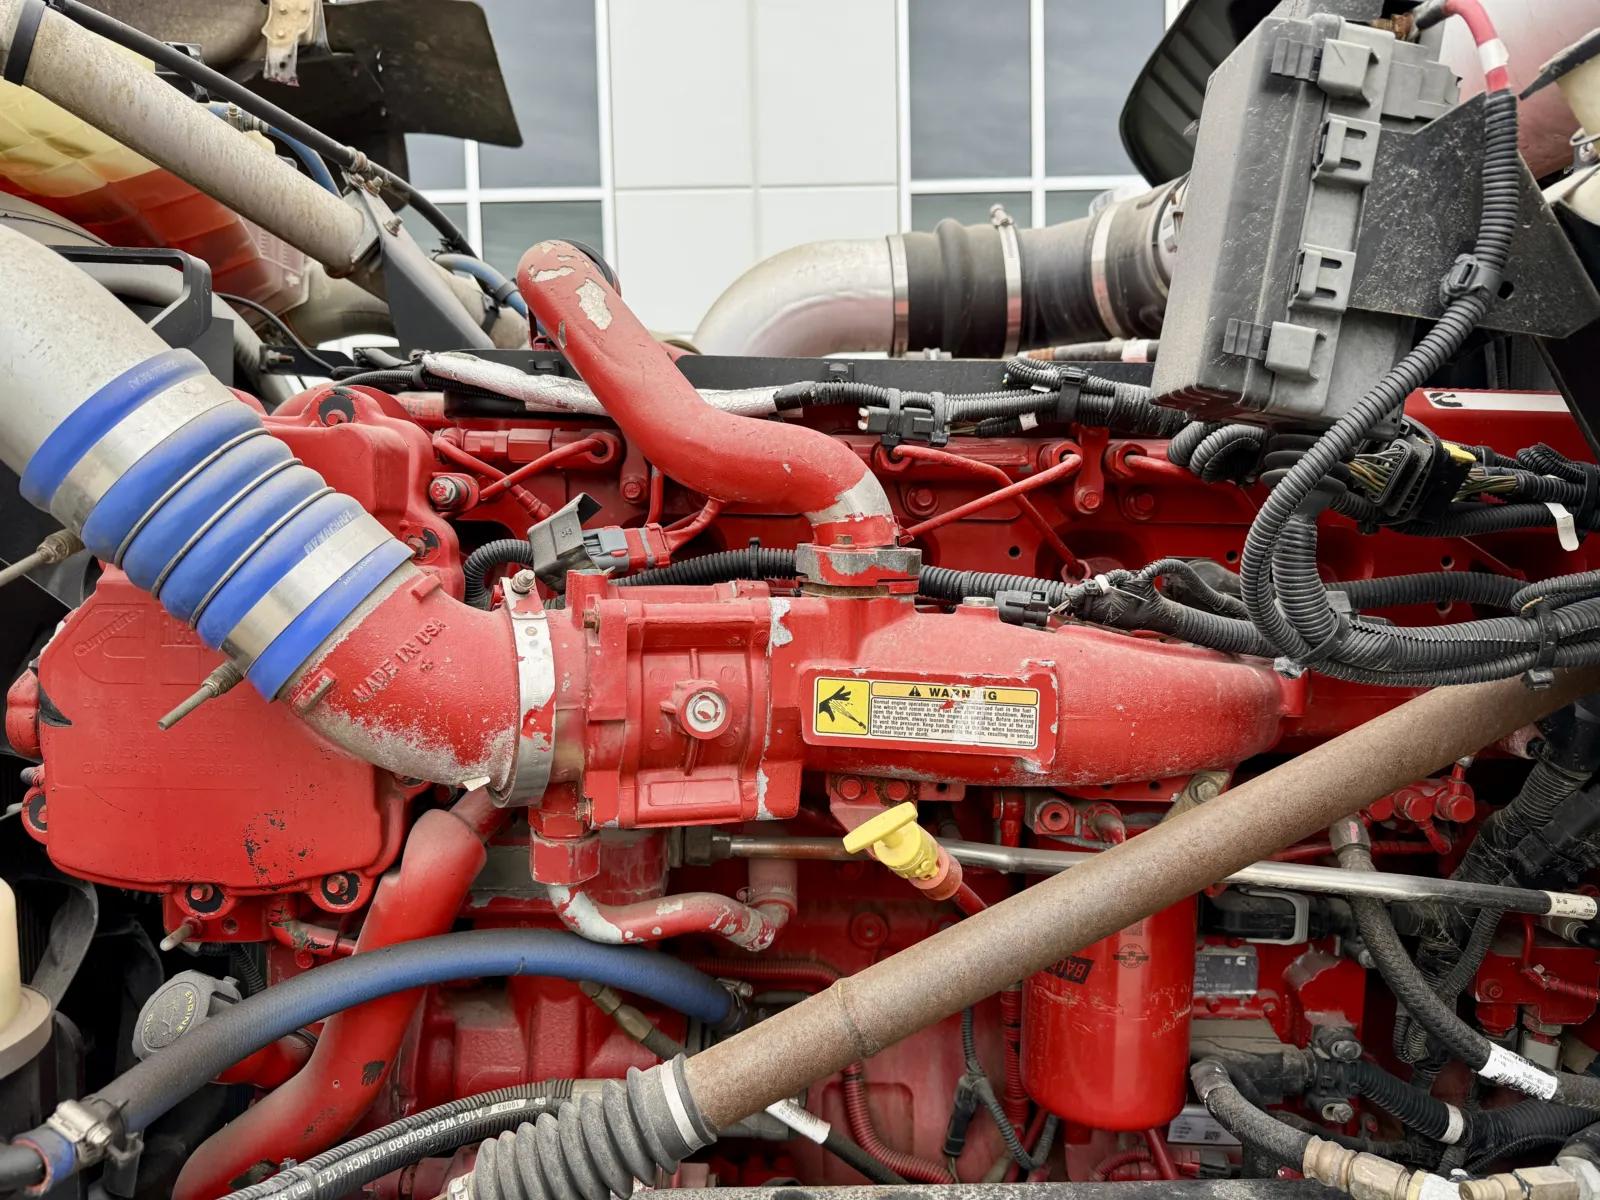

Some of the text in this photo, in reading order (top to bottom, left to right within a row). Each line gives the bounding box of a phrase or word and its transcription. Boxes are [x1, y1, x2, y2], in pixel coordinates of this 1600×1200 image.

[352, 617, 449, 702] MADE IN USA
[929, 687, 997, 700] WARNG
[176, 990, 194, 1033] ENGINE
[144, 1013, 153, 1032] OIL
[459, 1108, 483, 1123] A102
[389, 1115, 457, 1151] WEARGUARD
[373, 1147, 387, 1160] 1/2
[345, 1154, 371, 1172] INCH
